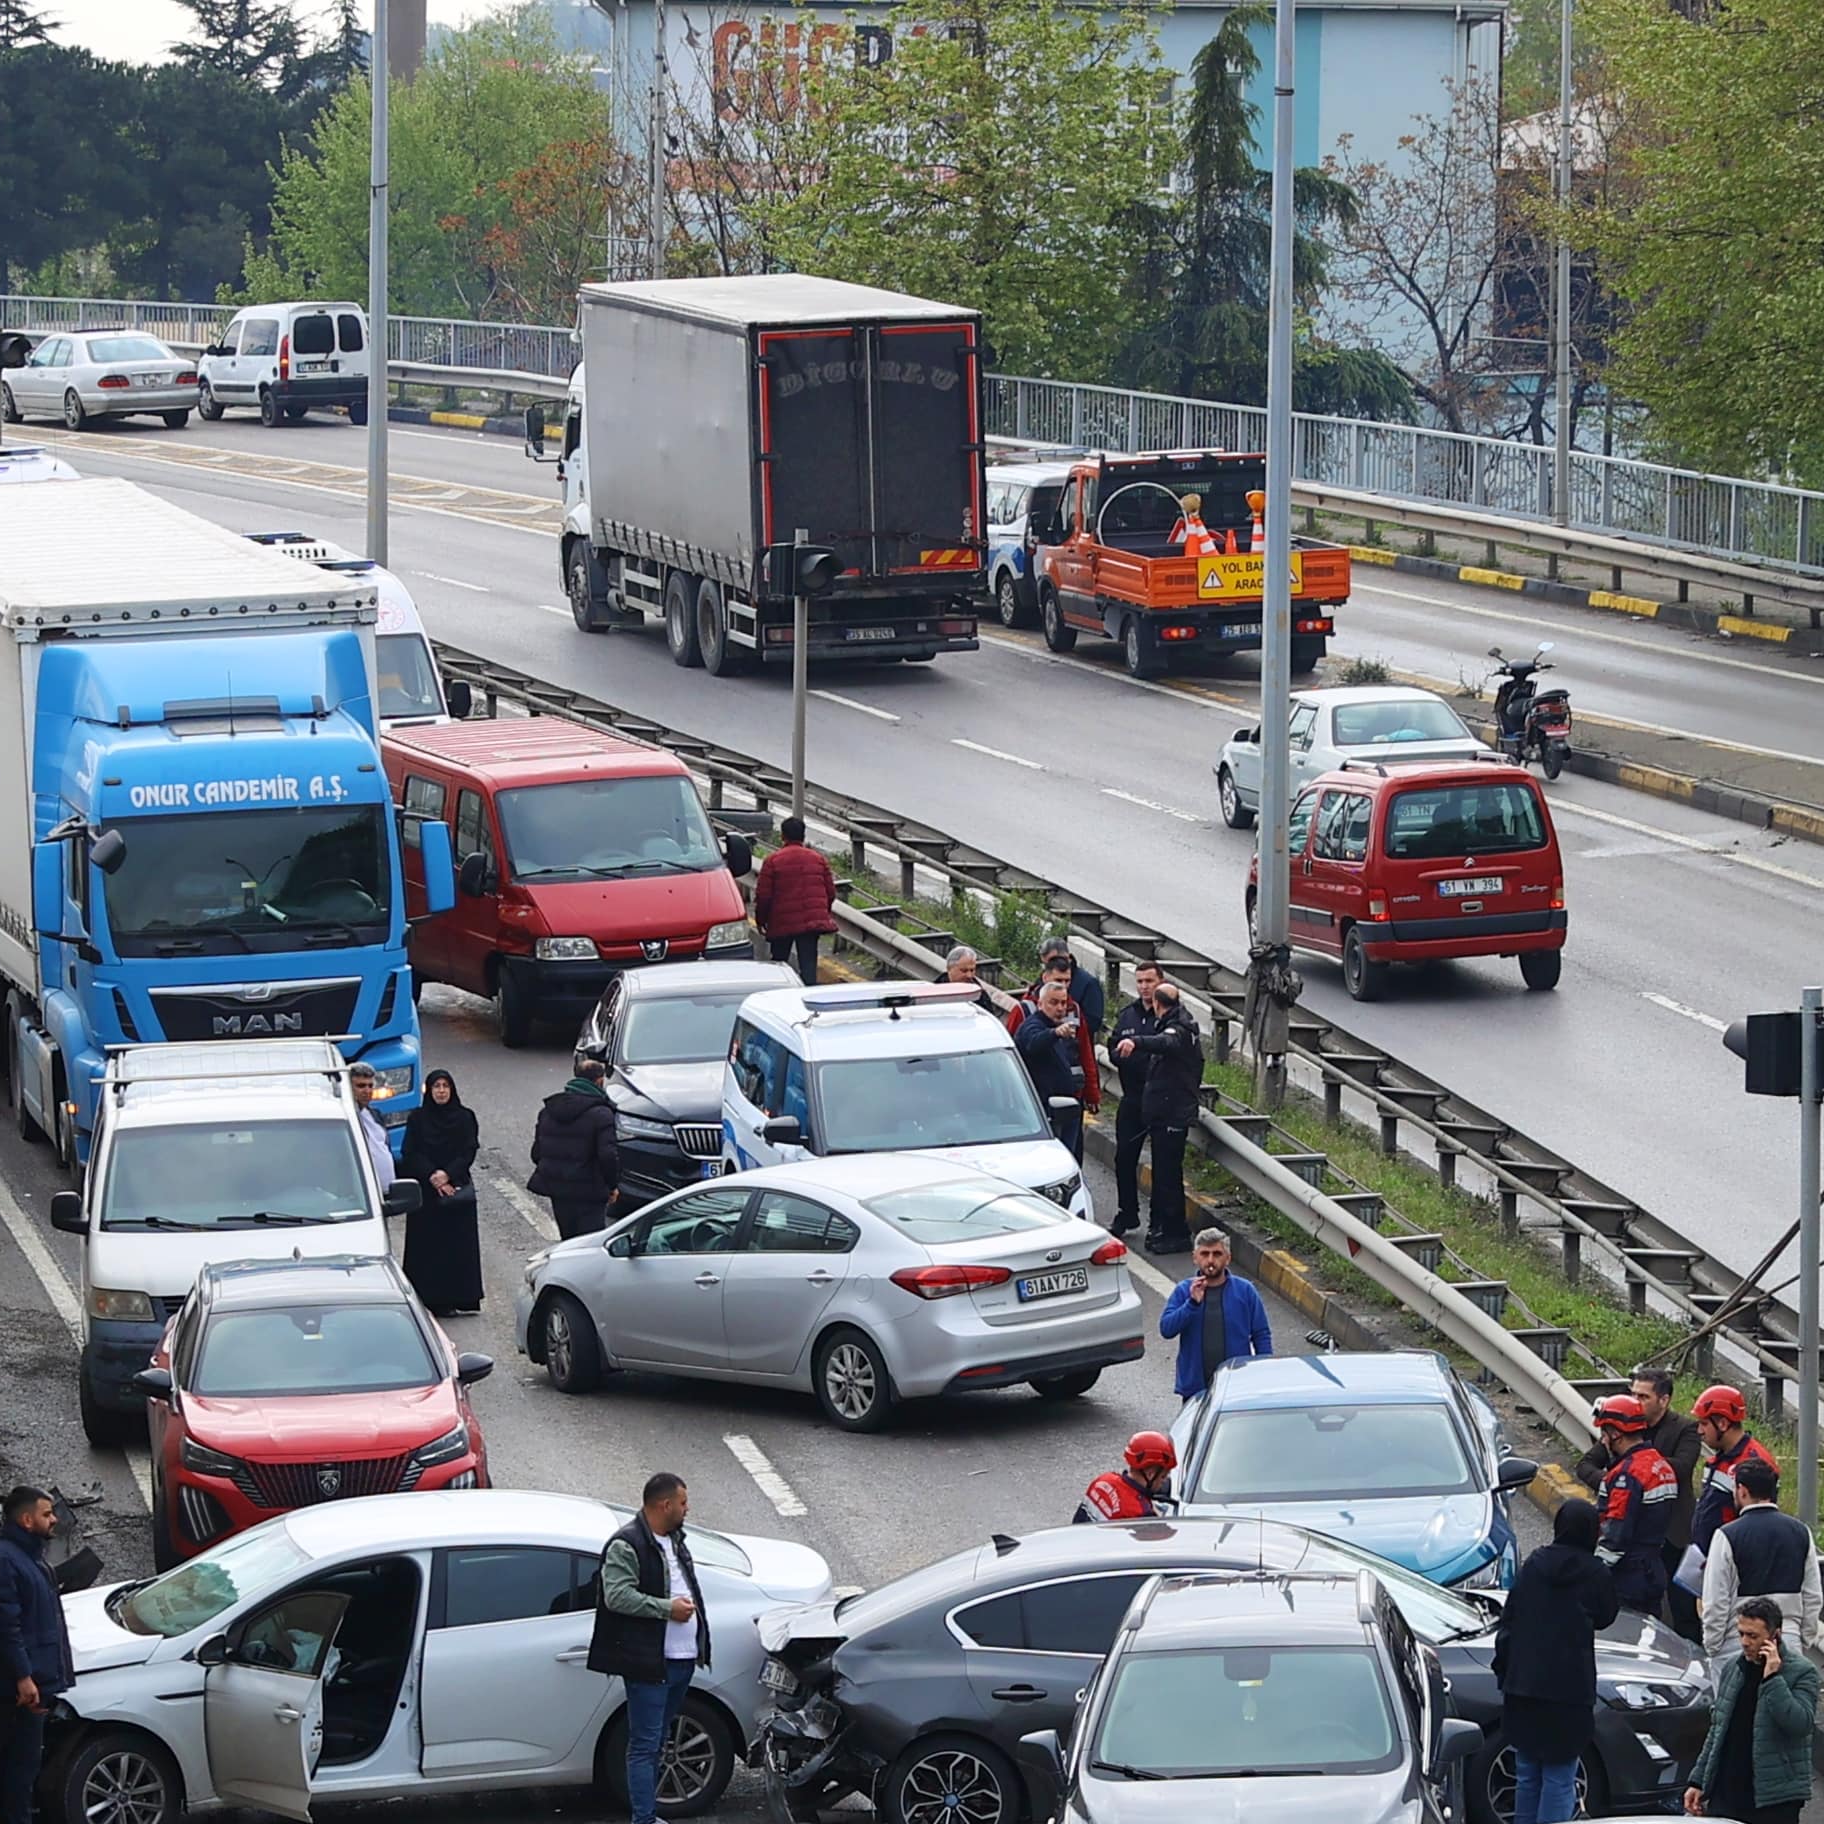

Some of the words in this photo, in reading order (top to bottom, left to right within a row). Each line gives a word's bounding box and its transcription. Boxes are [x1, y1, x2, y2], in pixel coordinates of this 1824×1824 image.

[1221, 561, 1243, 574] YOL
[1245, 561, 1265, 572] BAK
[1235, 579, 1264, 590] ARAC
[130, 783, 190, 808] ONUR
[194, 774, 300, 805] CANDEMİR
[309, 775, 349, 802] A.Ş.
[1445, 880, 1456, 891] 61
[1482, 879, 1499, 890] 394
[213, 1012, 303, 1035] MAN
[1062, 1271, 1085, 1289] 726
